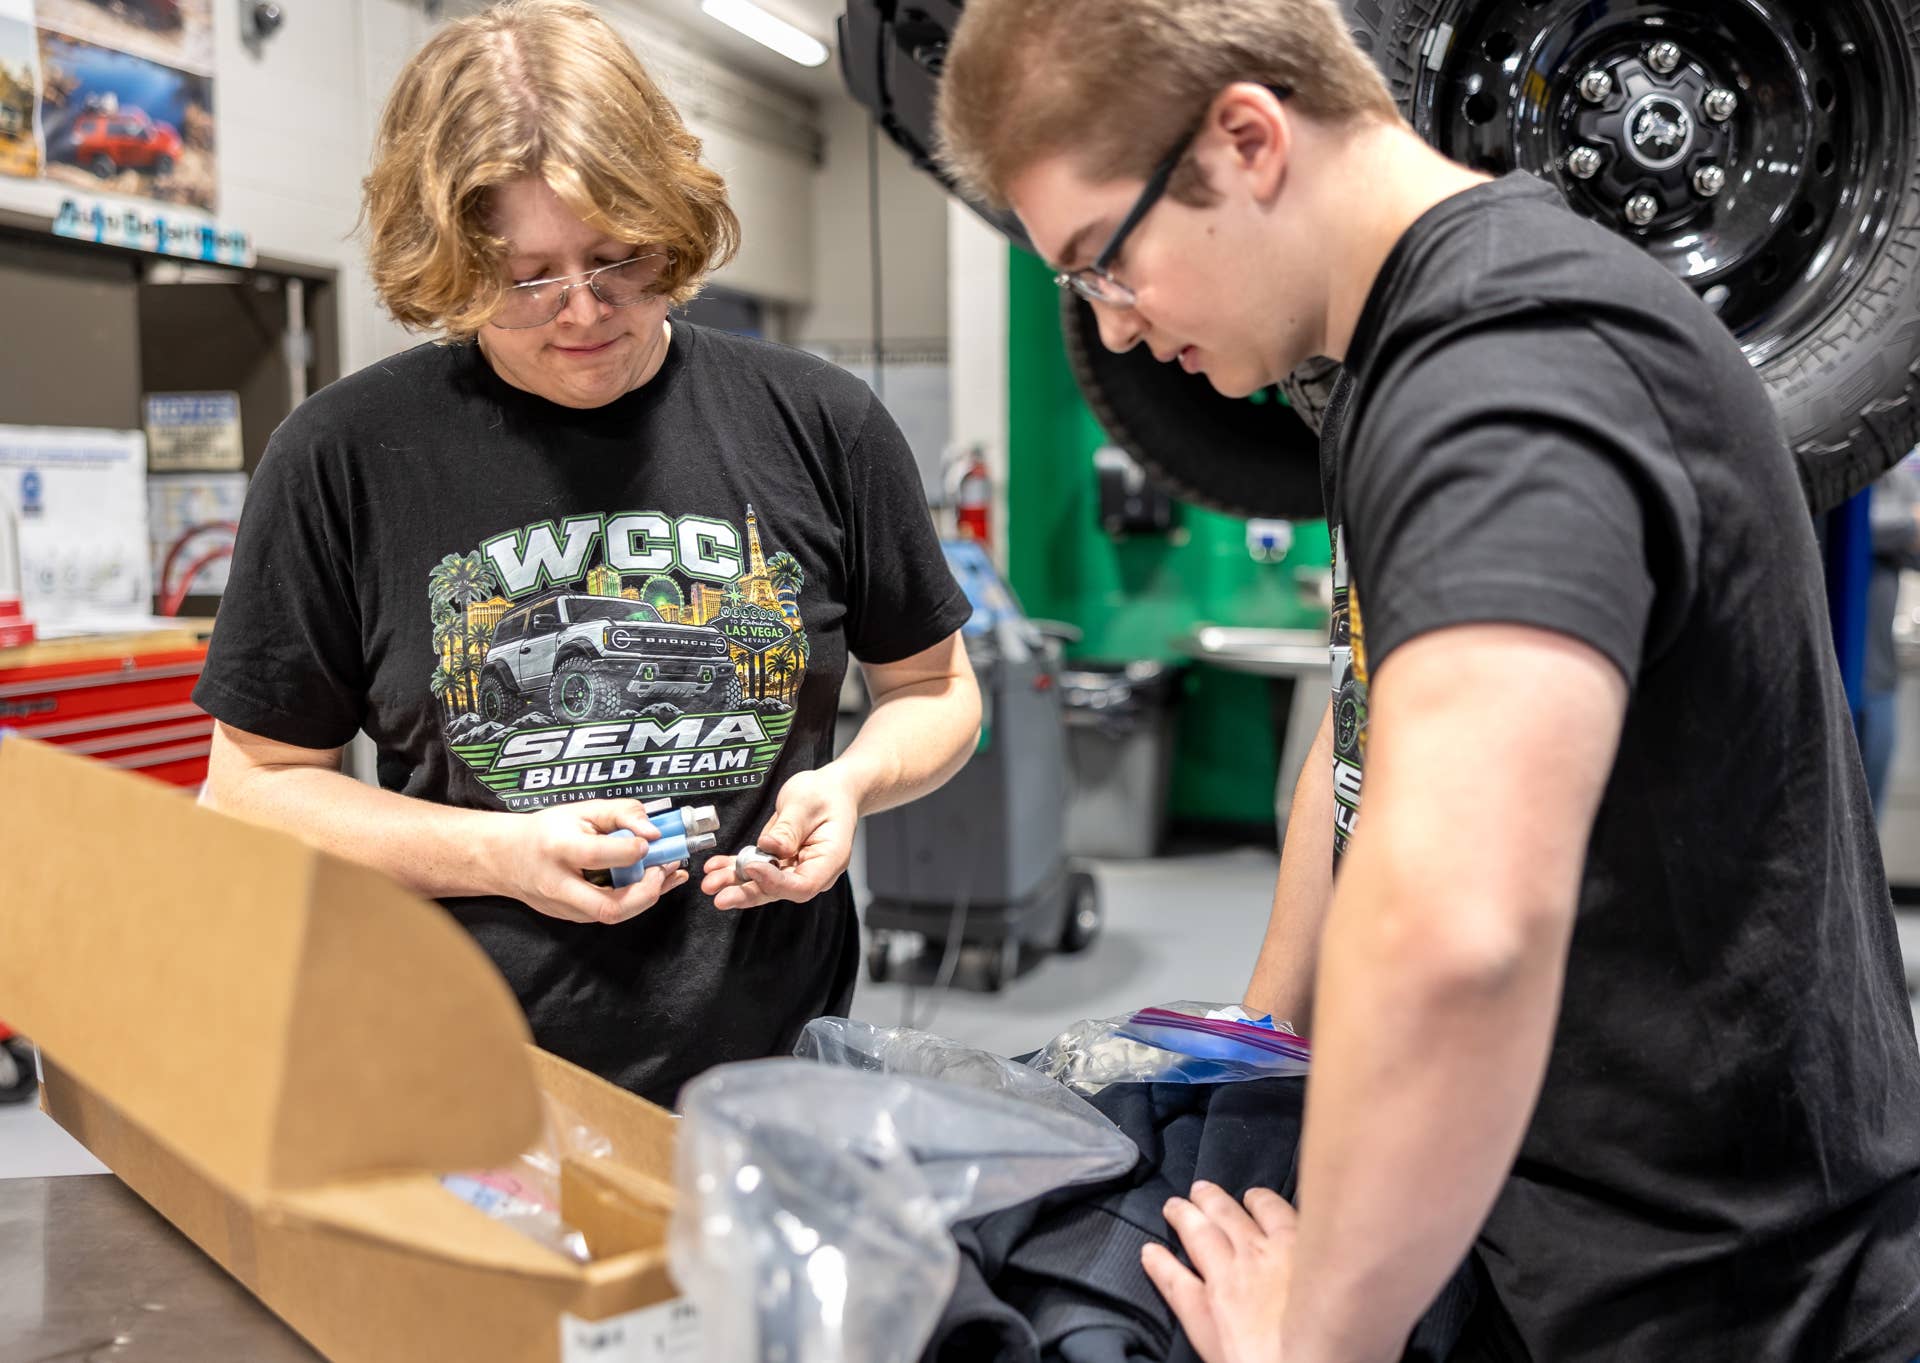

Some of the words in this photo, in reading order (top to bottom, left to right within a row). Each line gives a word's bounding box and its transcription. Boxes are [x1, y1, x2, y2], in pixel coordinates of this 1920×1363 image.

[482, 512, 743, 597] WCC
[721, 607, 782, 620] WELCOME
[646, 637, 707, 646] BRONCO
[725, 624, 748, 636] LAS
[750, 626, 784, 638] VEGAS
[497, 714, 766, 768] SEMA
[523, 759, 637, 790] BUILD
[646, 748, 750, 776] TEAM
[511, 791, 597, 808] WASHTENAW
[606, 782, 689, 797] COMMUNITY
[700, 774, 757, 789] COLLEGE
